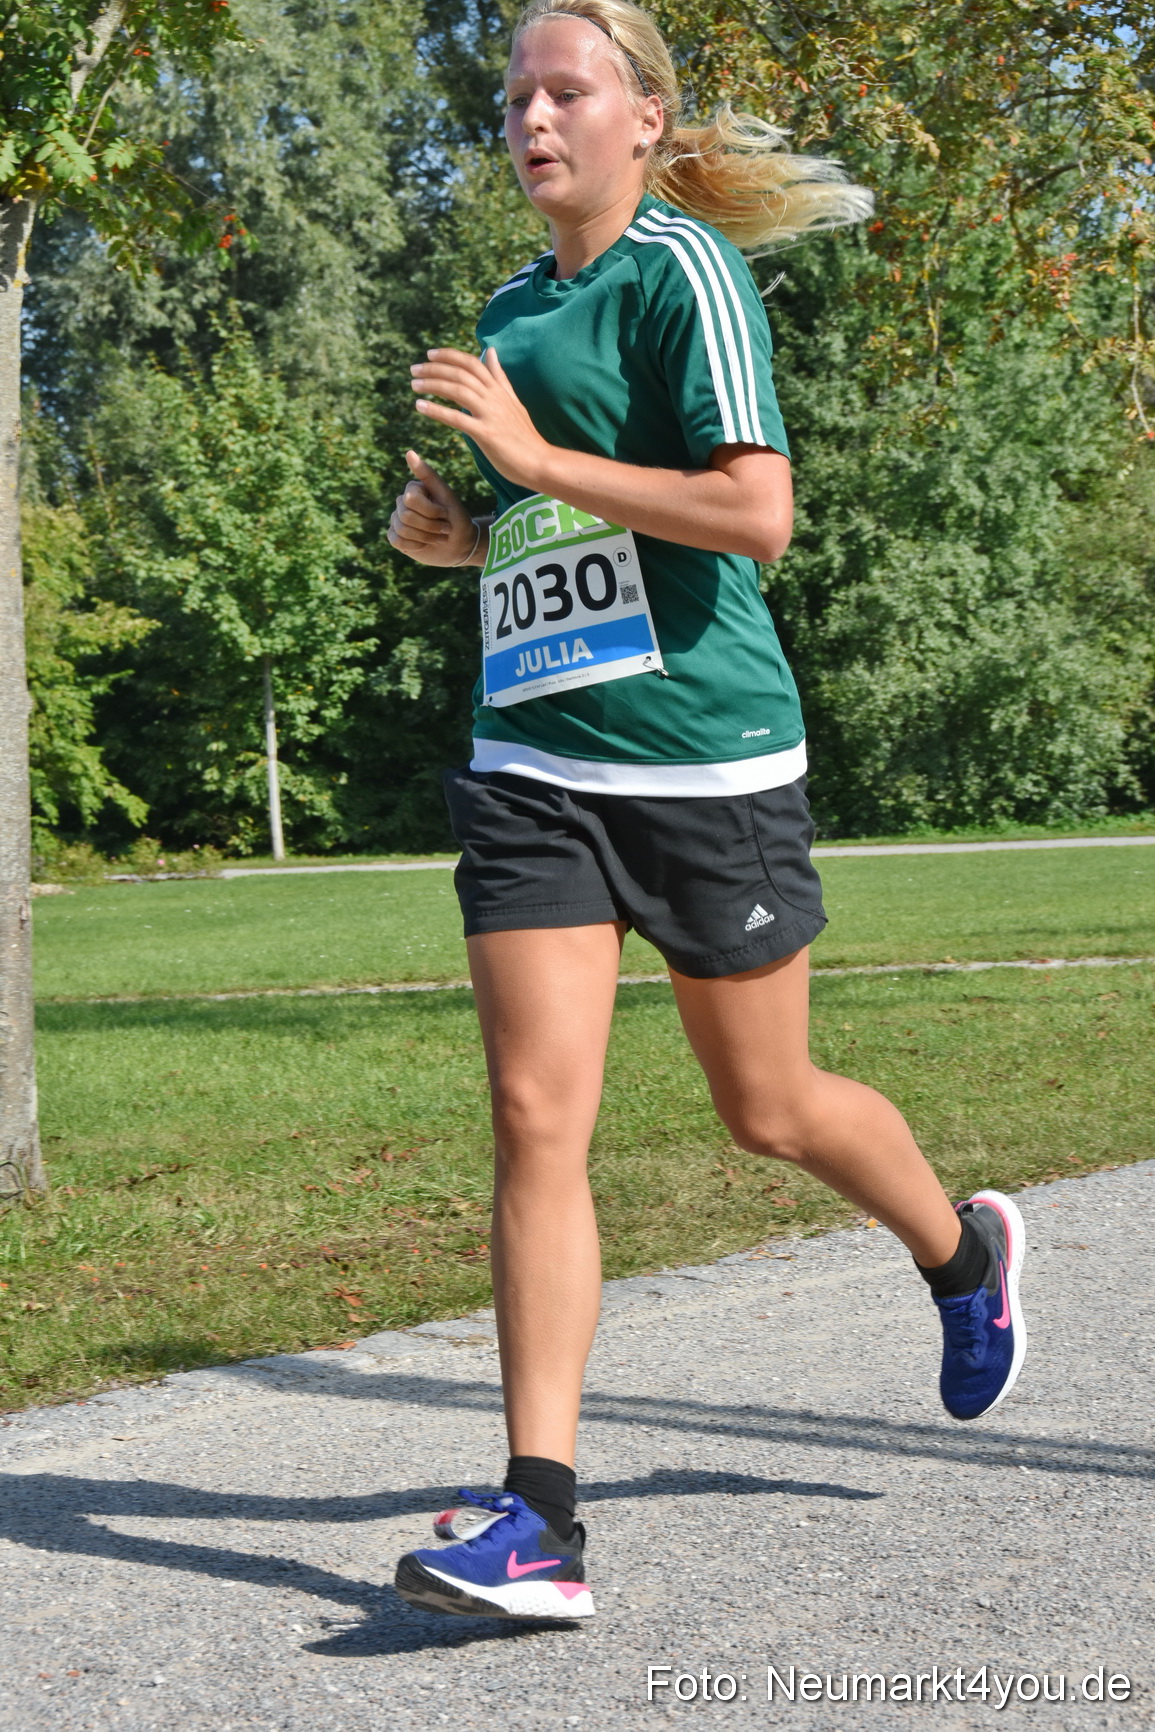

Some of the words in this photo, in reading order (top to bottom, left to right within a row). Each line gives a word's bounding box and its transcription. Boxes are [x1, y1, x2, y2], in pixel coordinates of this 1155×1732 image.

[494, 502, 600, 564] BOCK
[617, 552, 628, 563] D
[493, 553, 618, 640] 2030
[515, 638, 594, 677] JULIA
[741, 728, 771, 738] climalite
[745, 914, 775, 932] adidas
